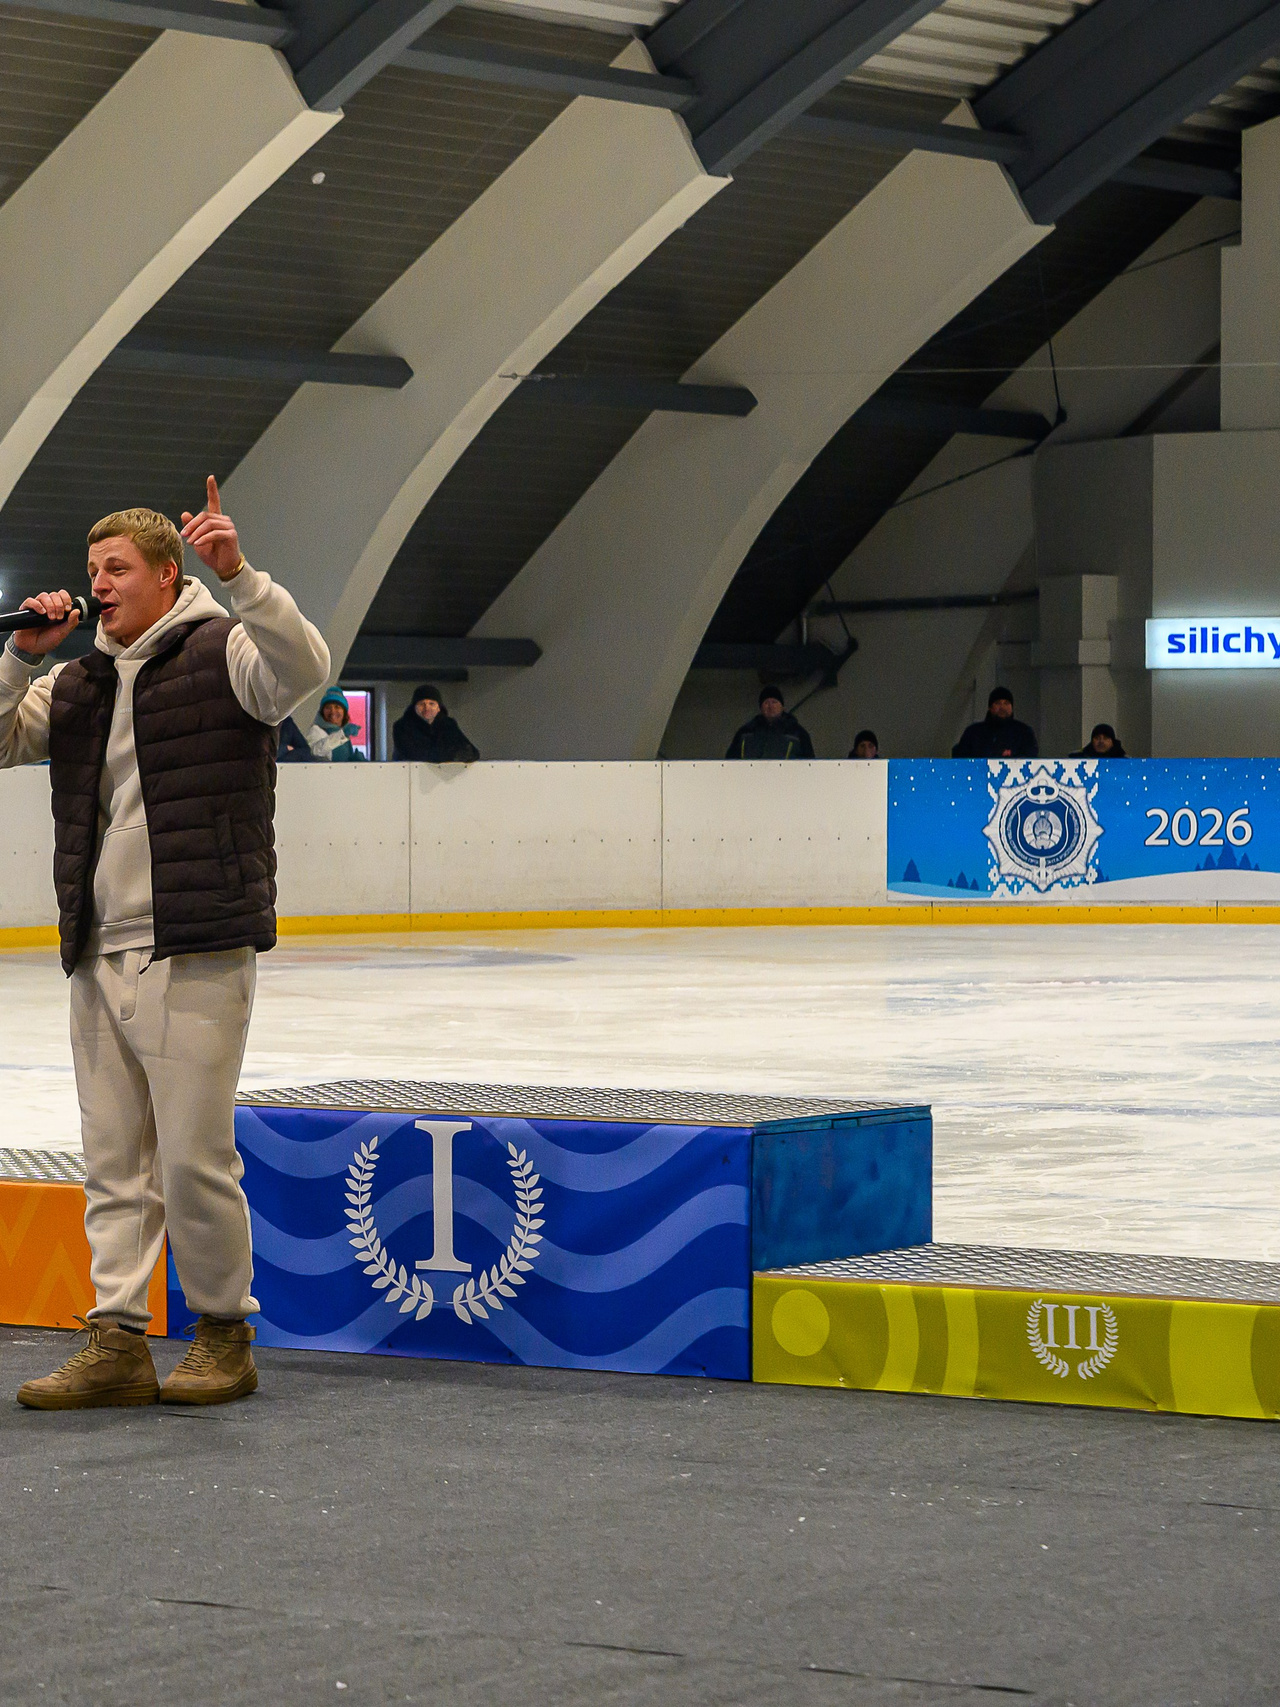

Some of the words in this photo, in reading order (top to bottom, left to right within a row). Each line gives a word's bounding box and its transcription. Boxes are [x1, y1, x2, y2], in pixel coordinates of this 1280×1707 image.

[1167, 626, 1280, 659] silichy
[1144, 807, 1253, 846] 2026
[414, 1119, 473, 1272] I
[1041, 1303, 1103, 1351] III
